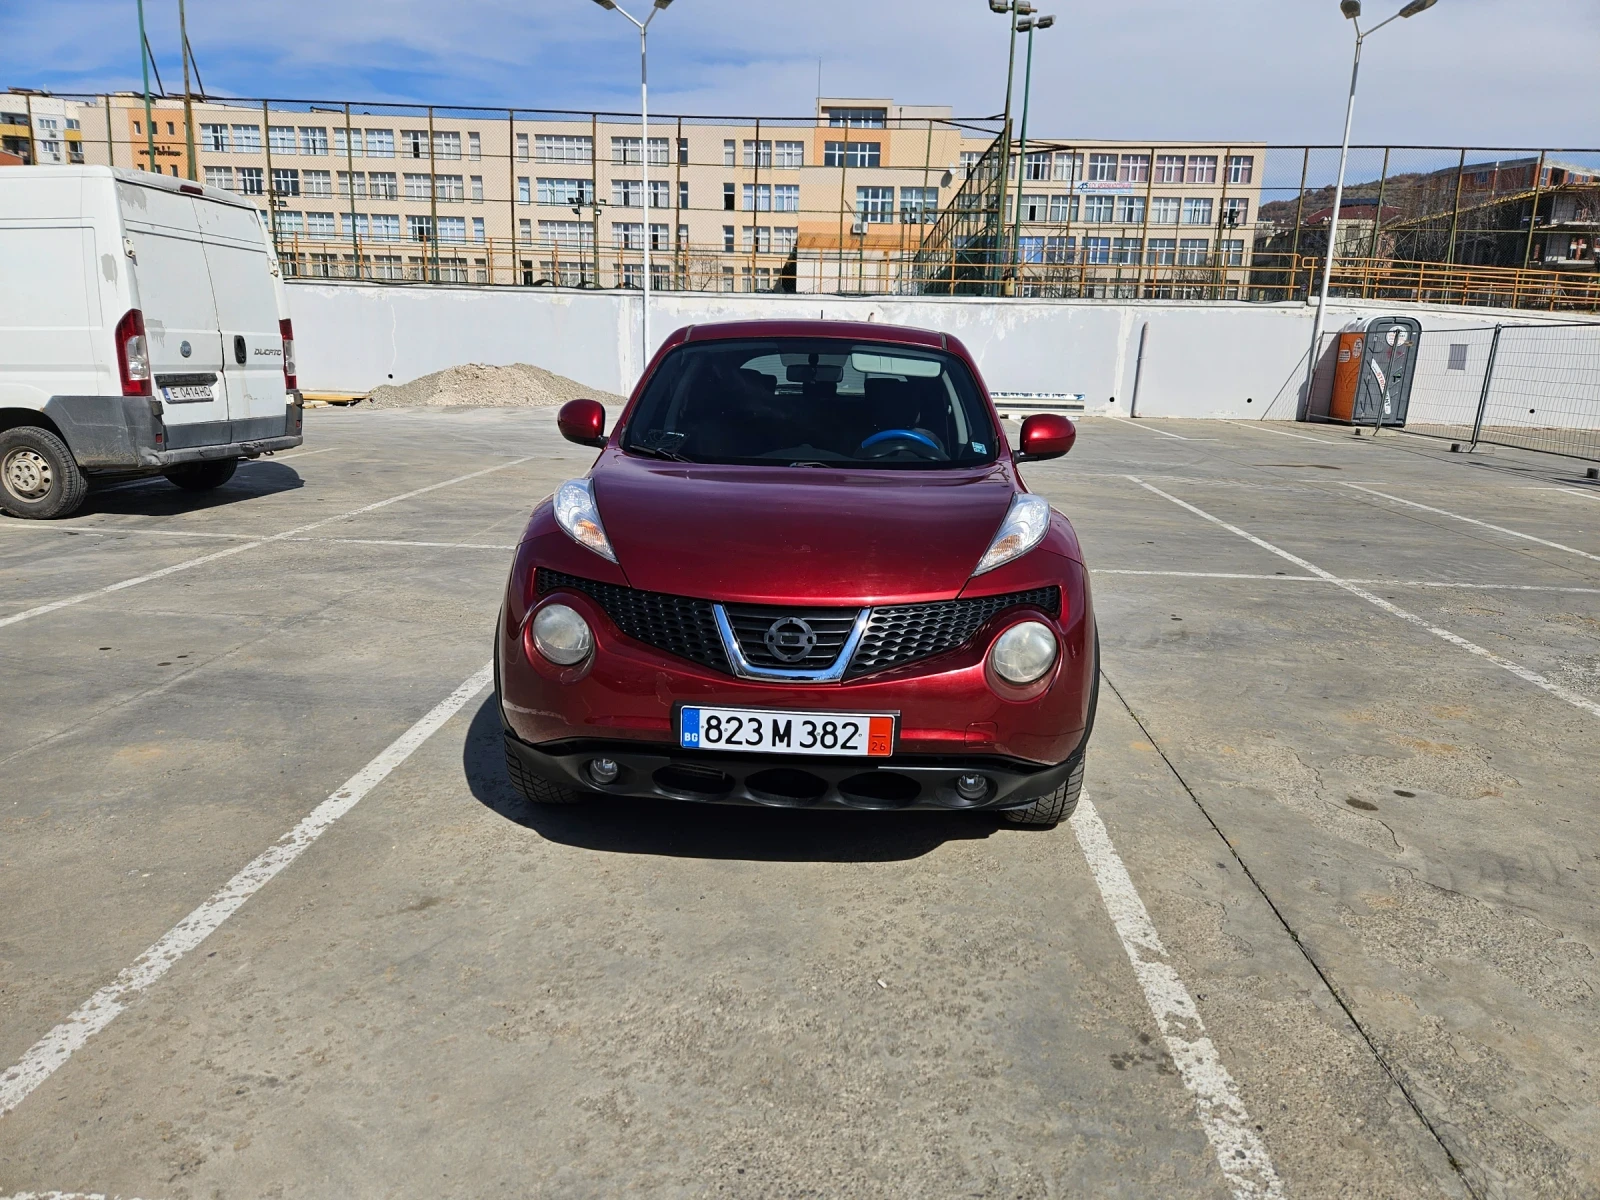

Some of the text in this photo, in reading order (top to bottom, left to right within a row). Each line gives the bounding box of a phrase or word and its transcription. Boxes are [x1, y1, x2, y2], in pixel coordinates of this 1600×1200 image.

[684, 715, 886, 752] BG 823 M 382 26
